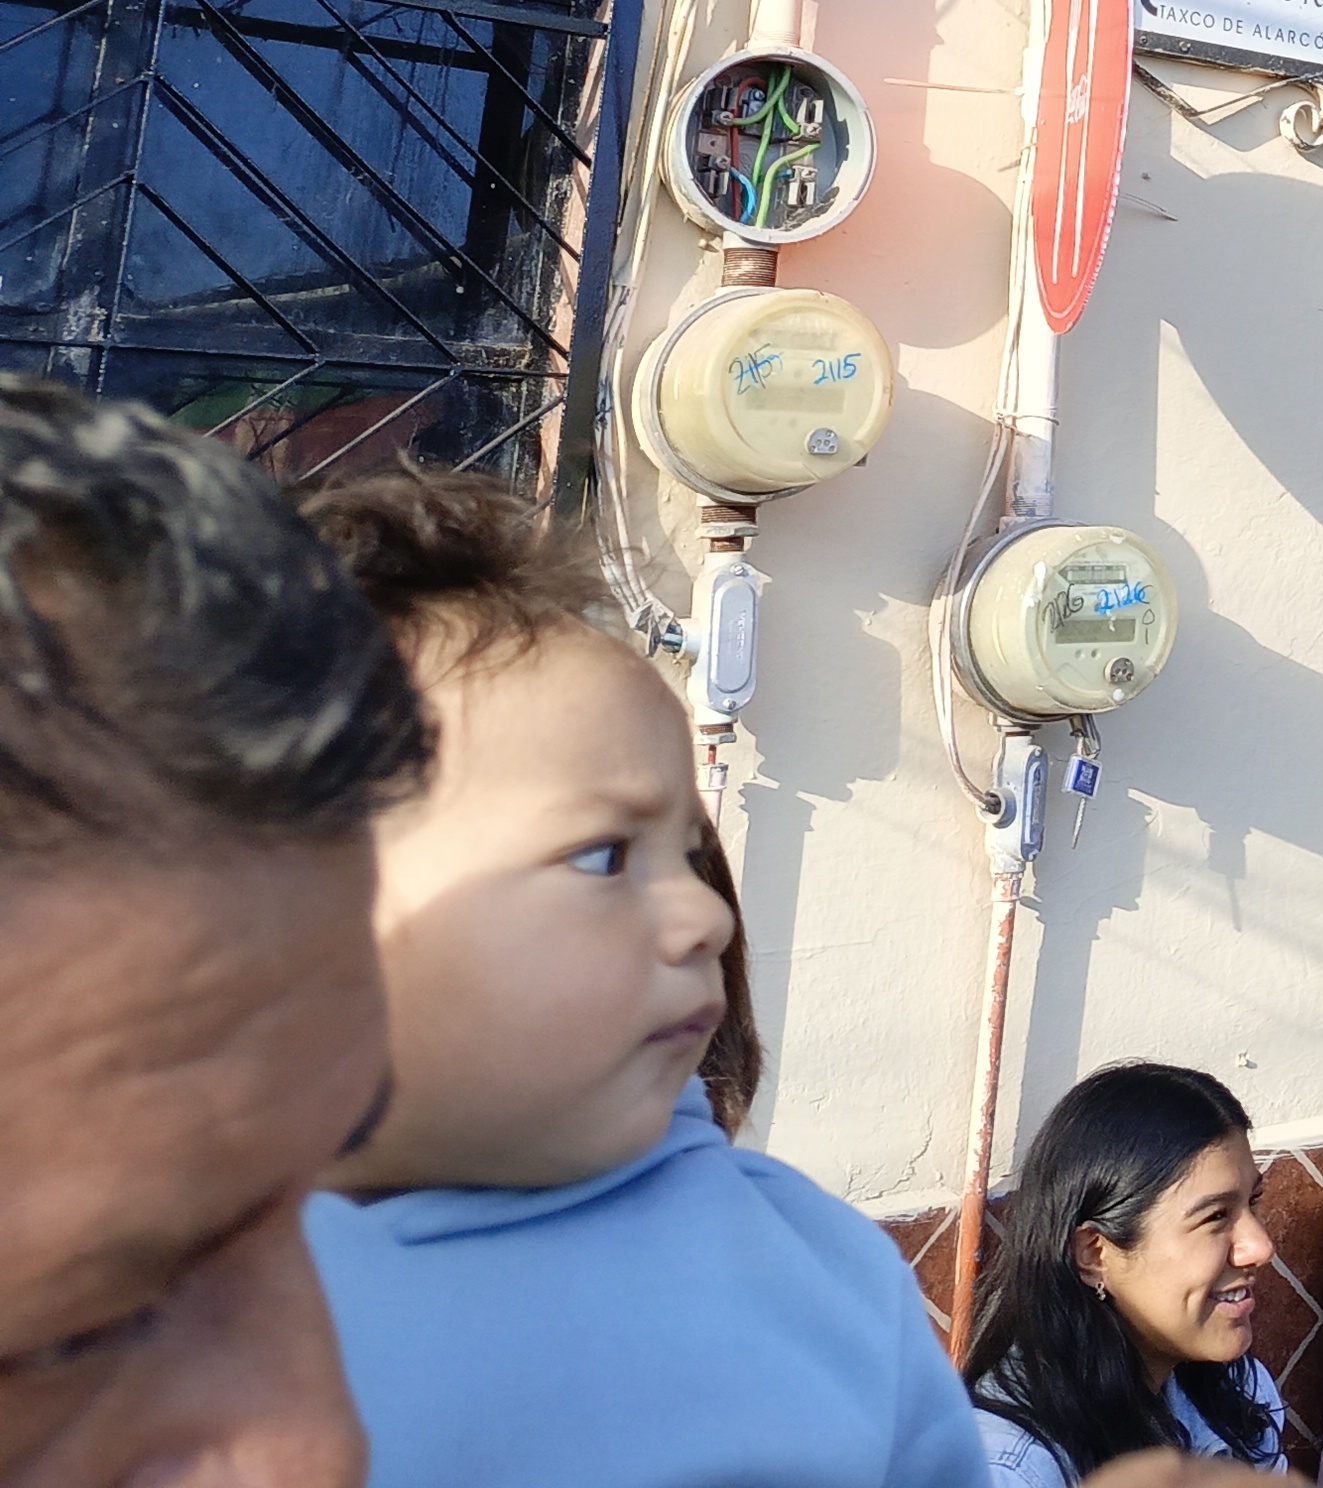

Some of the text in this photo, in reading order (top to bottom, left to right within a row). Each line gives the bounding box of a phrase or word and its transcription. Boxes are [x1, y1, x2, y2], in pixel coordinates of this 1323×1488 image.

[1160, 4, 1215, 29] TAXCO
[1223, 17, 1244, 35] DE
[812, 352, 862, 385] 2115
